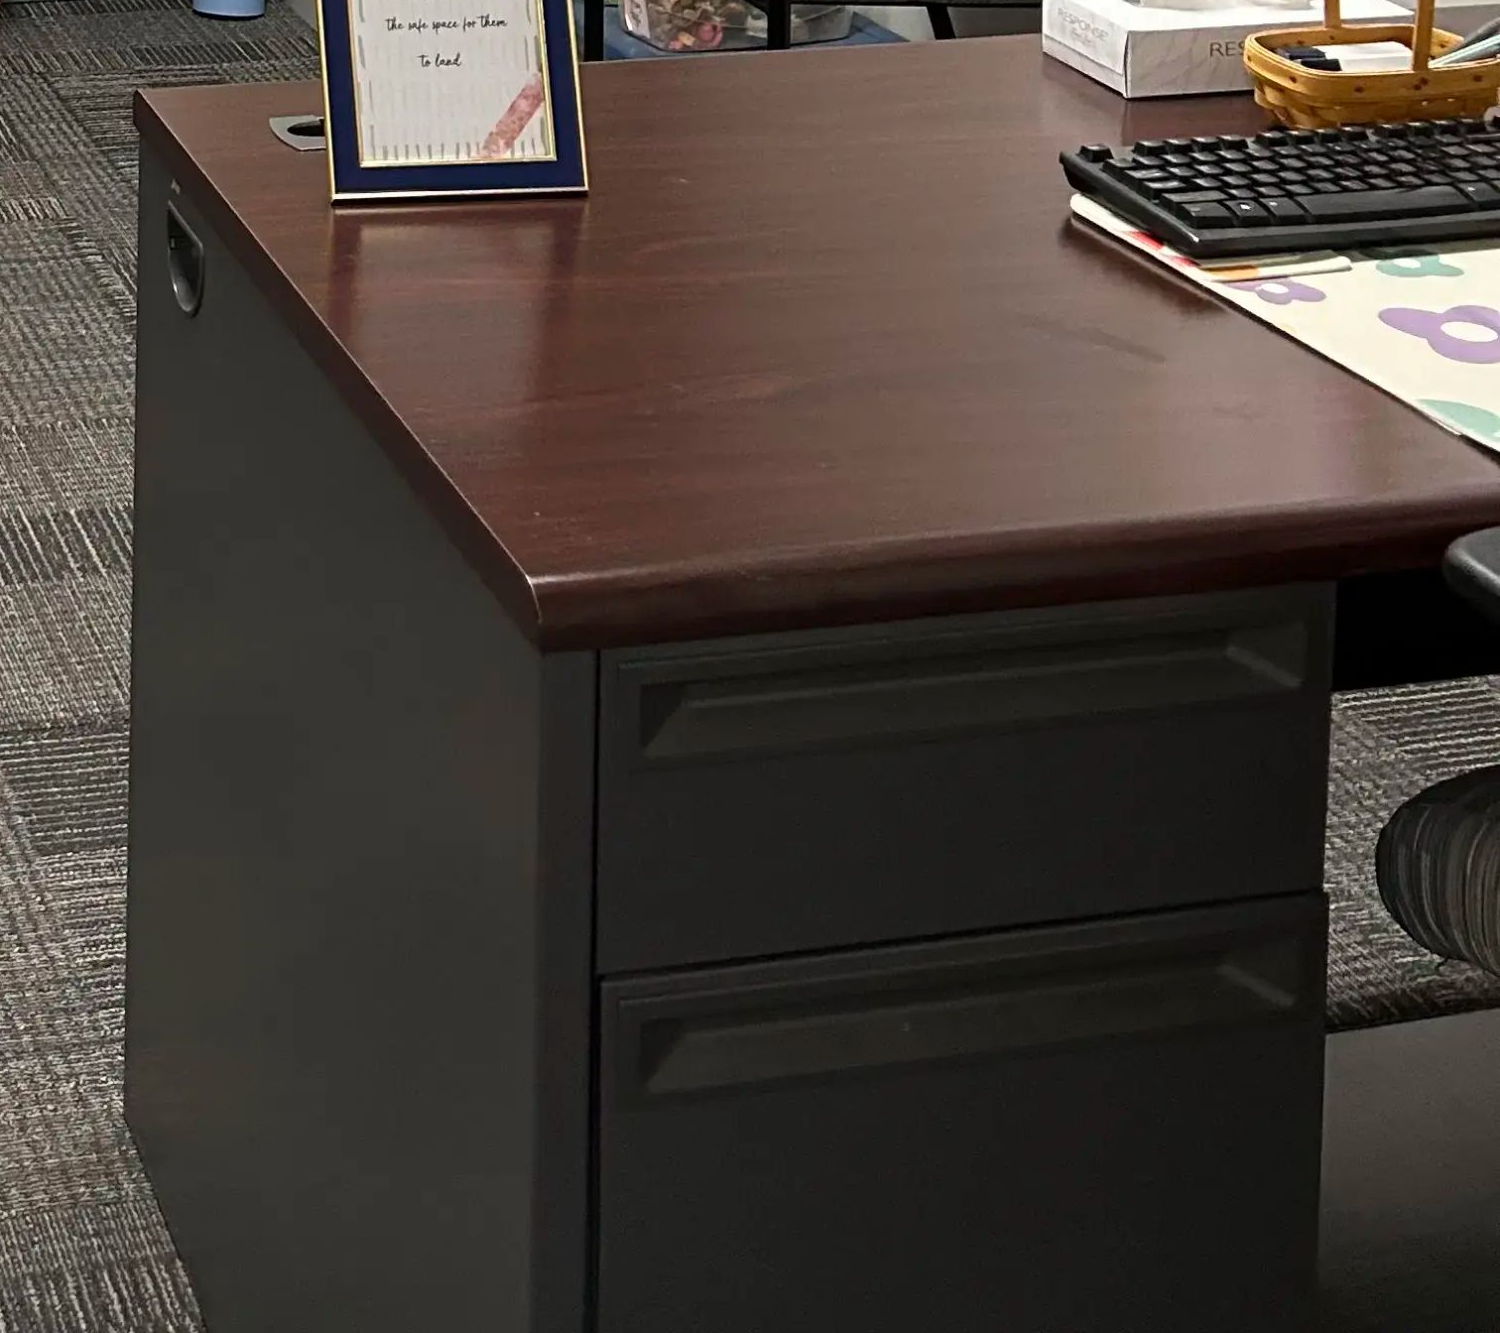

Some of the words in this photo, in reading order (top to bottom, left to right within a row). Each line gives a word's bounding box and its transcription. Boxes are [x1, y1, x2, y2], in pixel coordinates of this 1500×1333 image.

[385, 16, 404, 31] the
[408, 18, 428, 34] safe
[432, 20, 459, 34] space
[462, 17, 477, 33] for
[477, 13, 508, 28] them
[1056, 7, 1109, 43] RESPONSE
[418, 54, 432, 67] to
[435, 52, 462, 67] land
